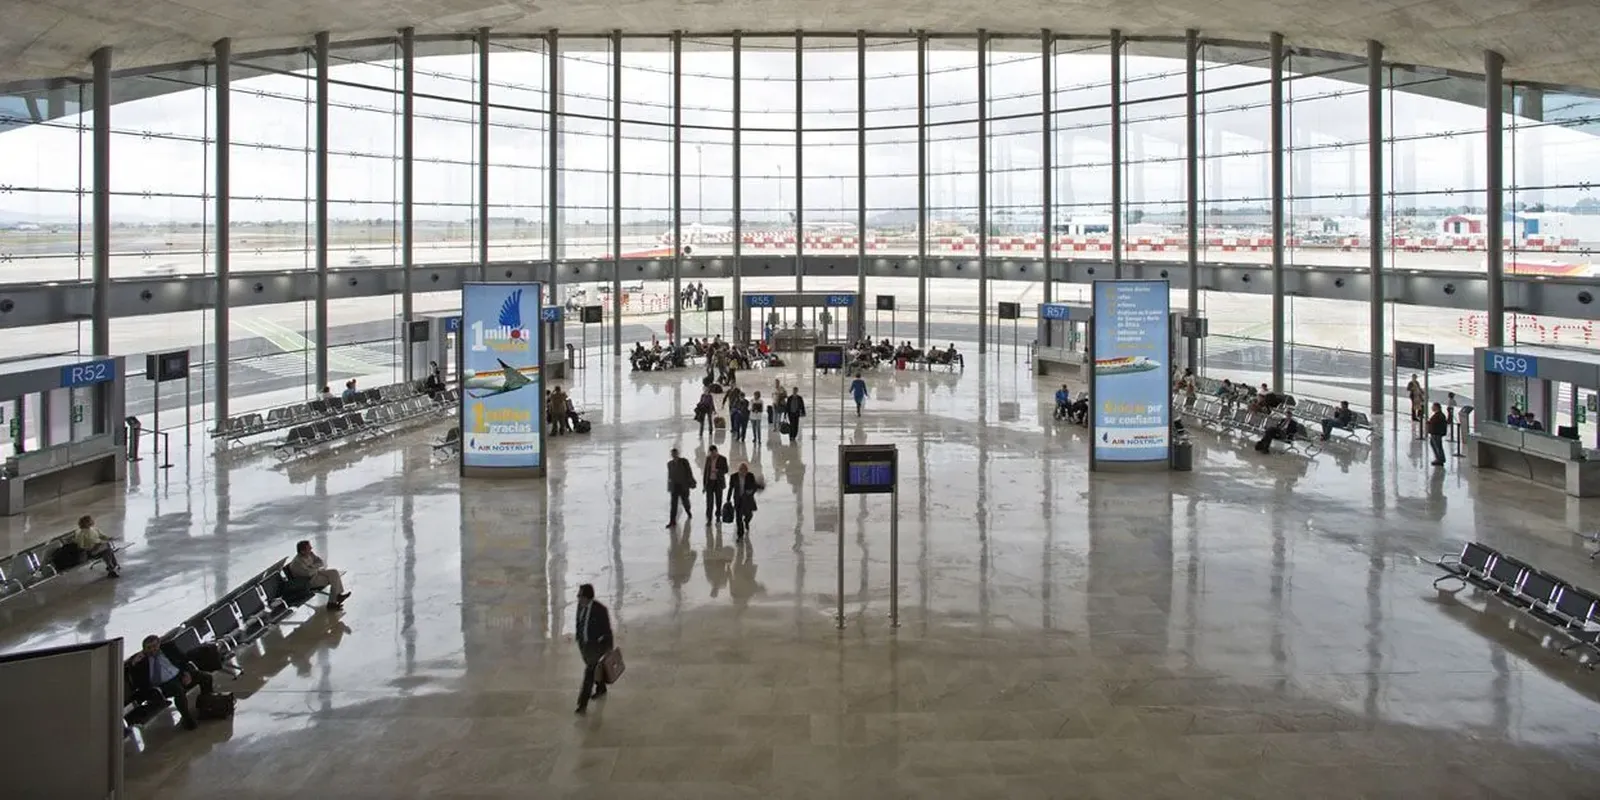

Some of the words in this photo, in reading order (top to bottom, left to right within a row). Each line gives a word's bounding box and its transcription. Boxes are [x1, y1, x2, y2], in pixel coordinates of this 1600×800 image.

[752, 296, 769, 305] R55
[542, 309, 555, 320] 54
[1047, 307, 1065, 316] R57
[471, 320, 487, 351] 1
[1493, 354, 1527, 373] R59
[72, 363, 105, 383] R52
[1147, 404, 1162, 415] por
[1103, 416, 1116, 424] su
[490, 422, 532, 433] gracias
